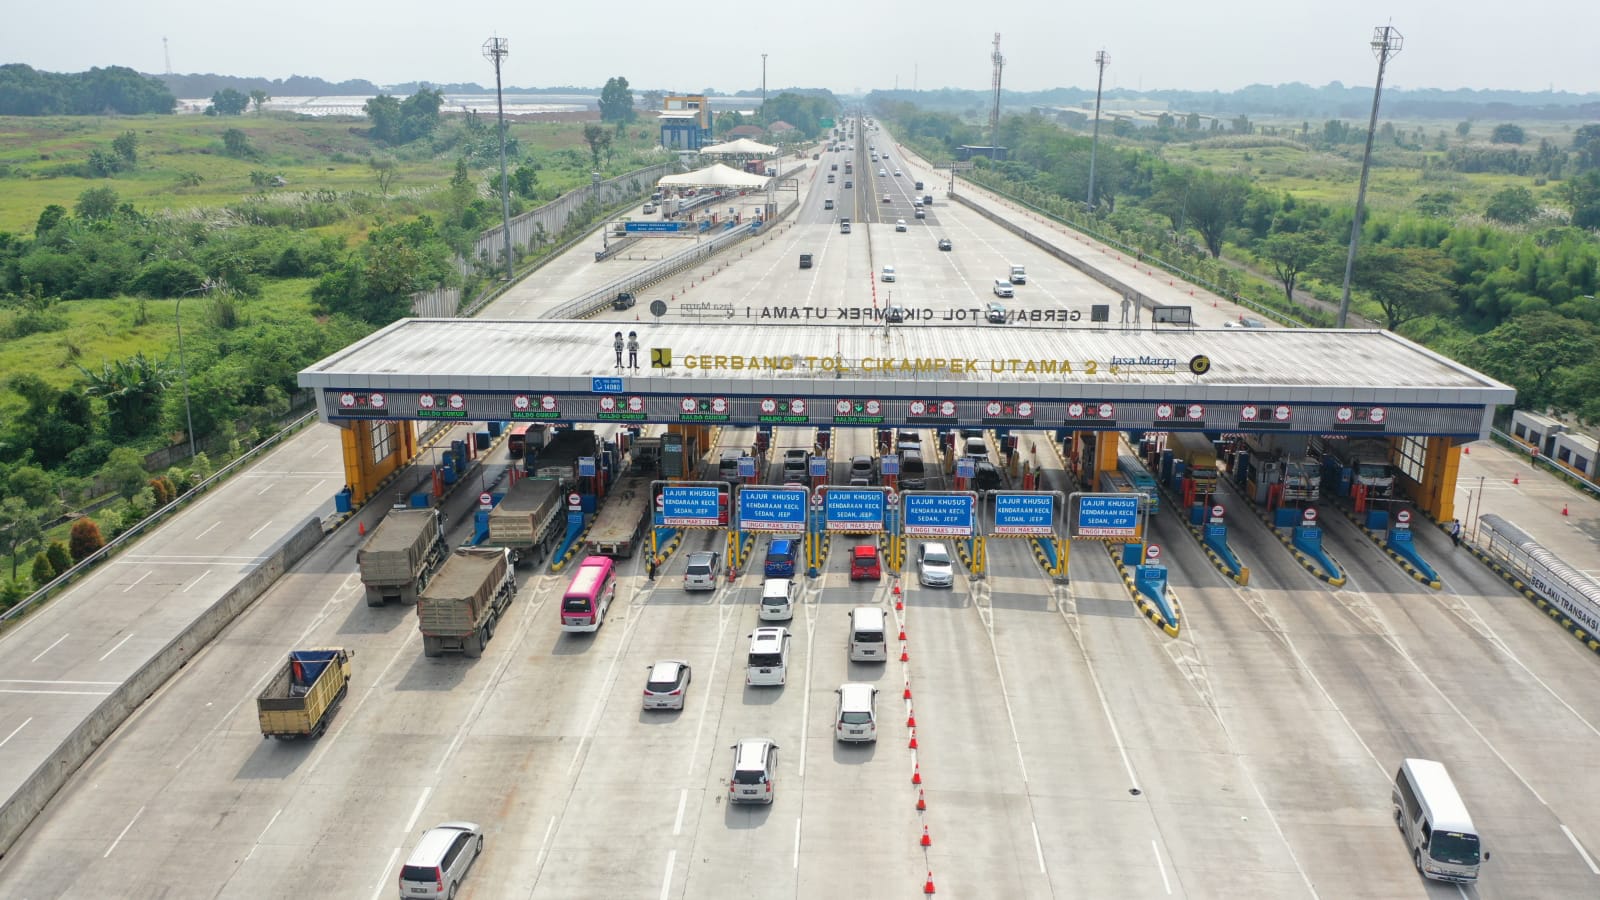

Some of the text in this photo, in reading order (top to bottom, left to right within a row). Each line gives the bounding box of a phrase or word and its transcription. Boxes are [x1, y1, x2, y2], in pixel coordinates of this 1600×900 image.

[684, 355, 1098, 375] GERBANG TOL CIKAMPEK UTAMA 2
[1112, 355, 1176, 368] Jasa Marga
[1530, 576, 1599, 632] BERLAKU TRANSAKSI
